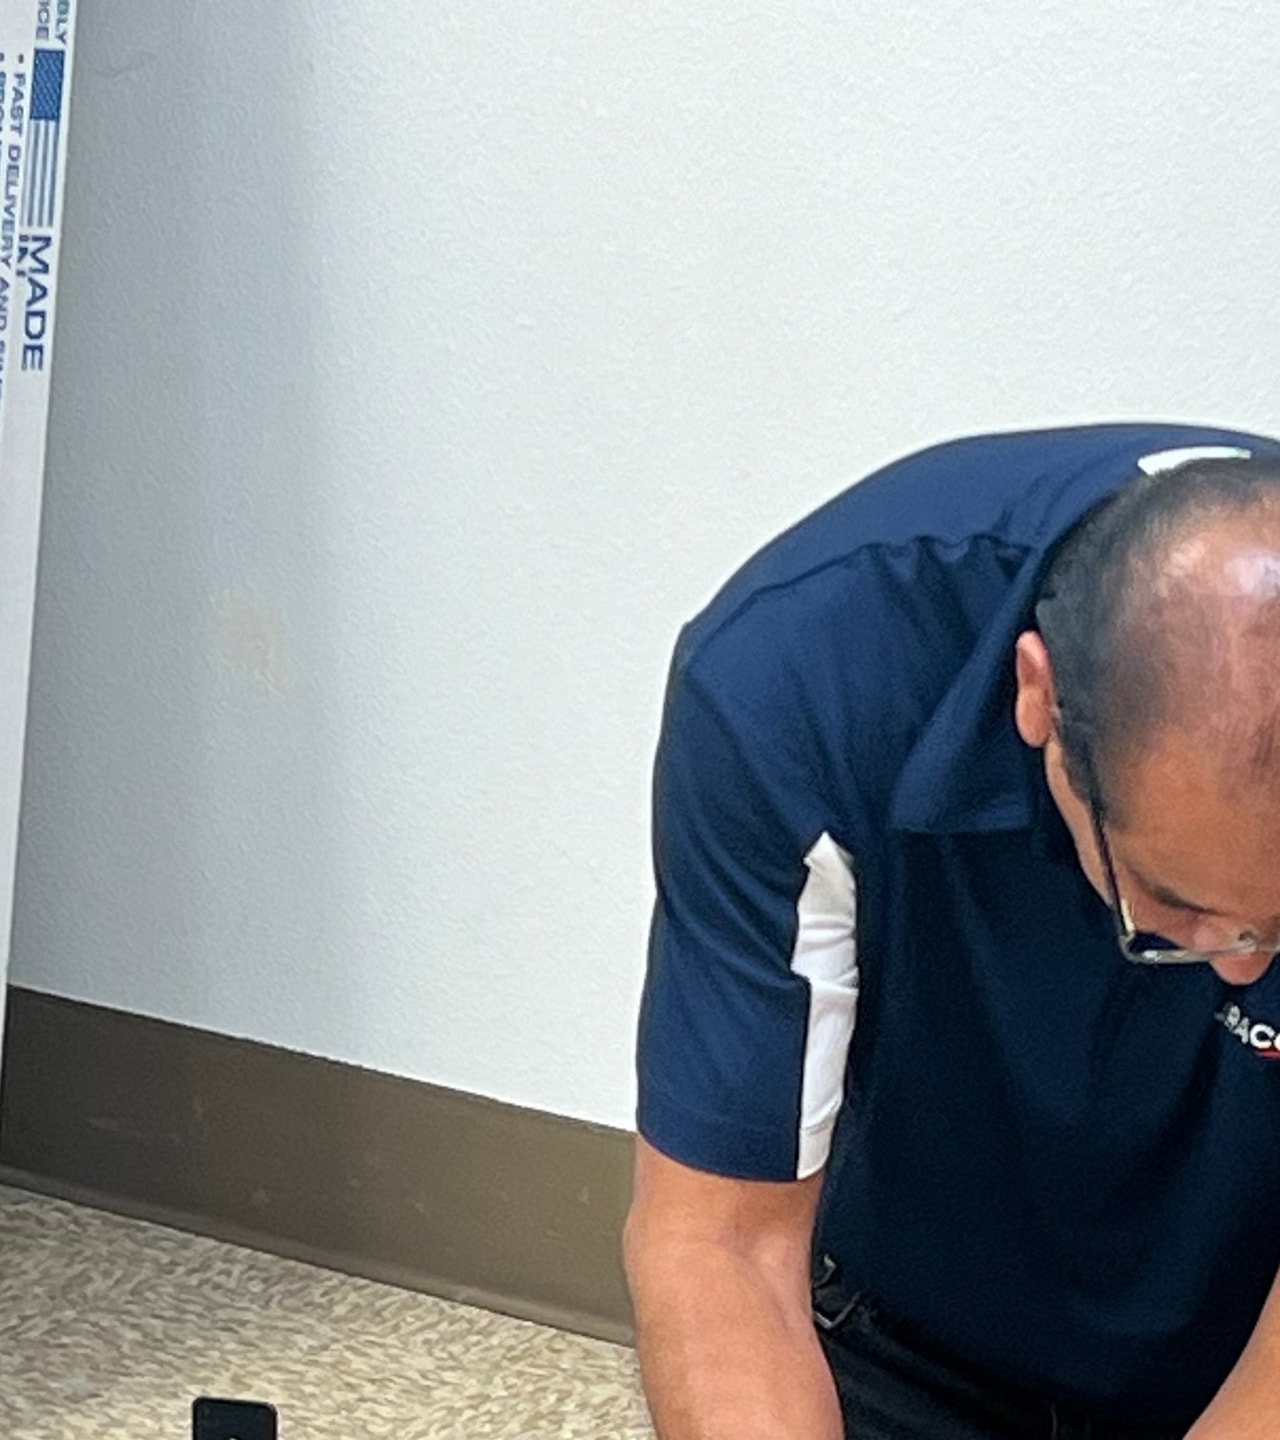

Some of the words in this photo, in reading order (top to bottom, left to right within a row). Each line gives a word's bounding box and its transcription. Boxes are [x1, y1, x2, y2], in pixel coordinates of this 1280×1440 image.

[10, 72, 26, 137] FAST
[0, 144, 22, 269] DELIVERY
[21, 233, 52, 372] MADE
